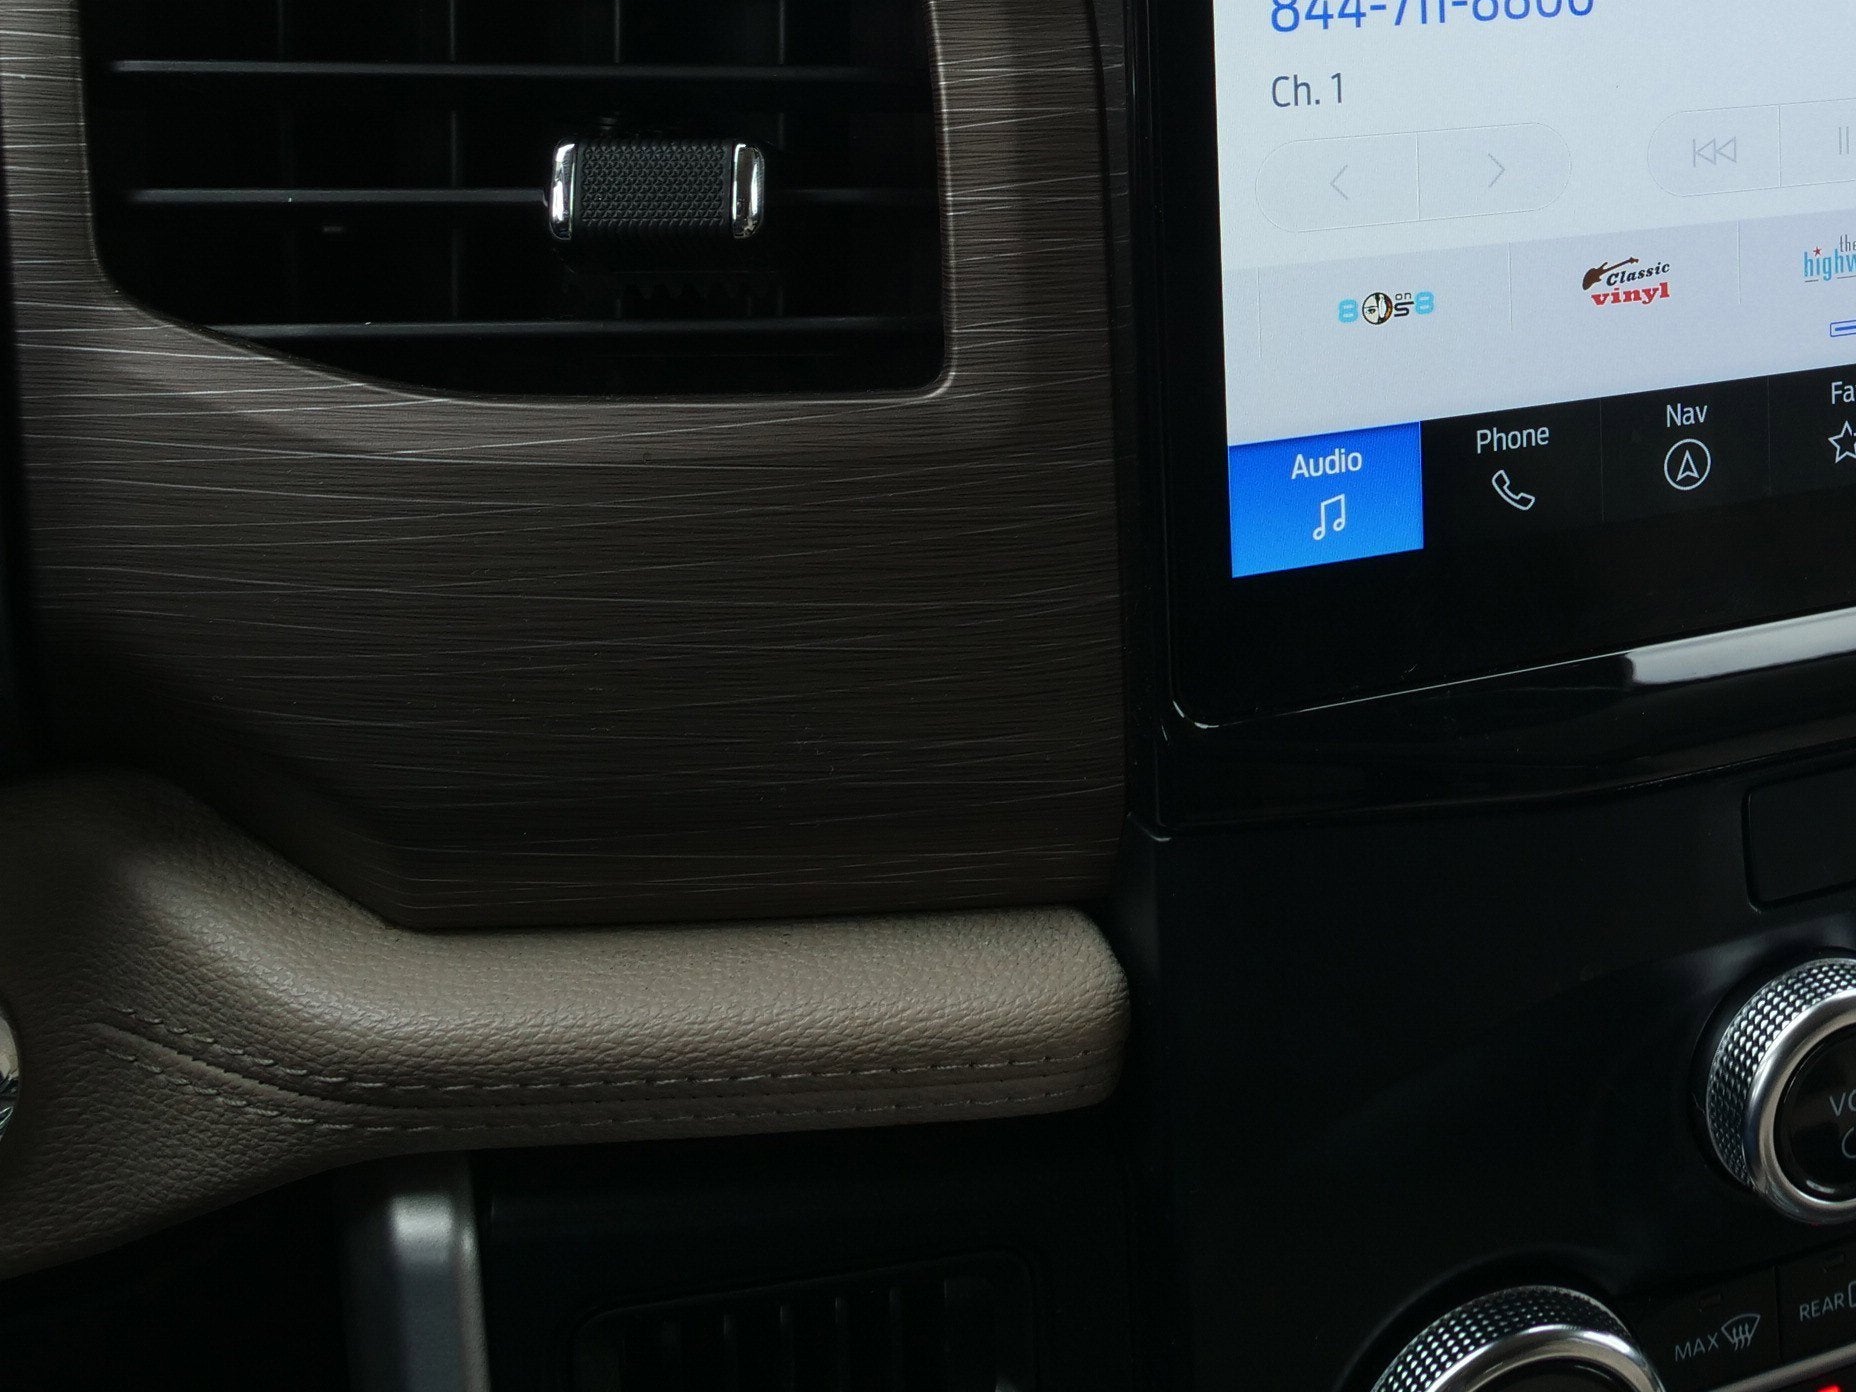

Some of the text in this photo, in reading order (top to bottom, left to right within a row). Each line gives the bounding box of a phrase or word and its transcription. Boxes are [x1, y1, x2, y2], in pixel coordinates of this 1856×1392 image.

[1271, 72, 1344, 108] Ch. 1
[1606, 261, 1670, 286] Classic
[1591, 282, 1670, 306] vinyl
[1666, 402, 1707, 427] Nav
[1477, 421, 1550, 454] Phone
[1291, 446, 1363, 480] Audio
[1799, 1293, 1846, 1324] REAR
[1674, 1333, 1719, 1364] MAX
